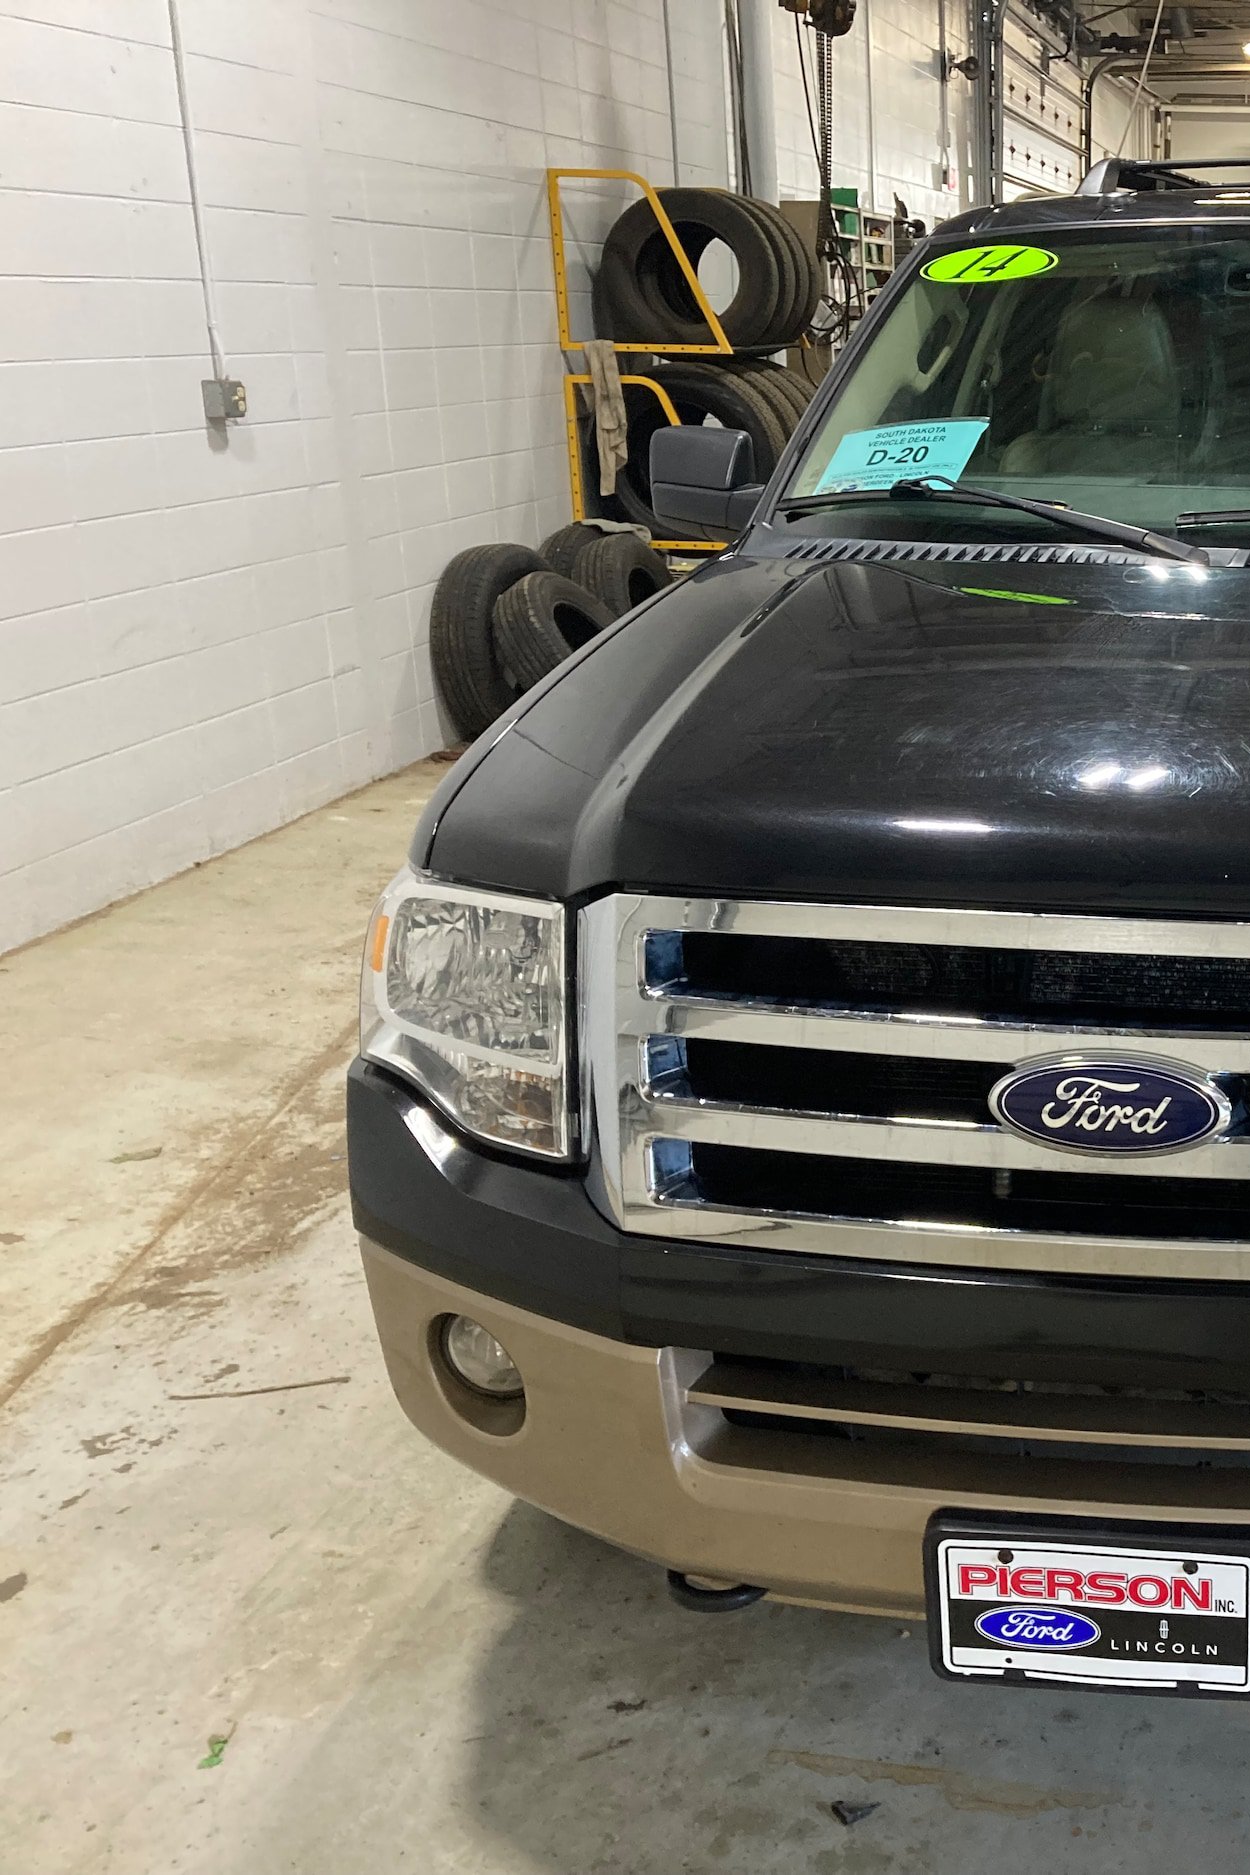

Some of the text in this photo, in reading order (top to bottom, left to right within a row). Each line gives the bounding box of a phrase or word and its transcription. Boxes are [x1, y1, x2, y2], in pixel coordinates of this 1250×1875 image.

[943, 248, 1029, 280] 14
[868, 435, 946, 447] VEHICLE DEALER
[875, 426, 946, 439] SOUTH DAKOTA
[866, 445, 929, 466] D-20
[1041, 1076, 1172, 1135] Ford
[957, 1563, 1238, 1614] PIERSON INC.
[1000, 1611, 1074, 1642] Ford
[1110, 1639, 1219, 1656] LINCOLN
